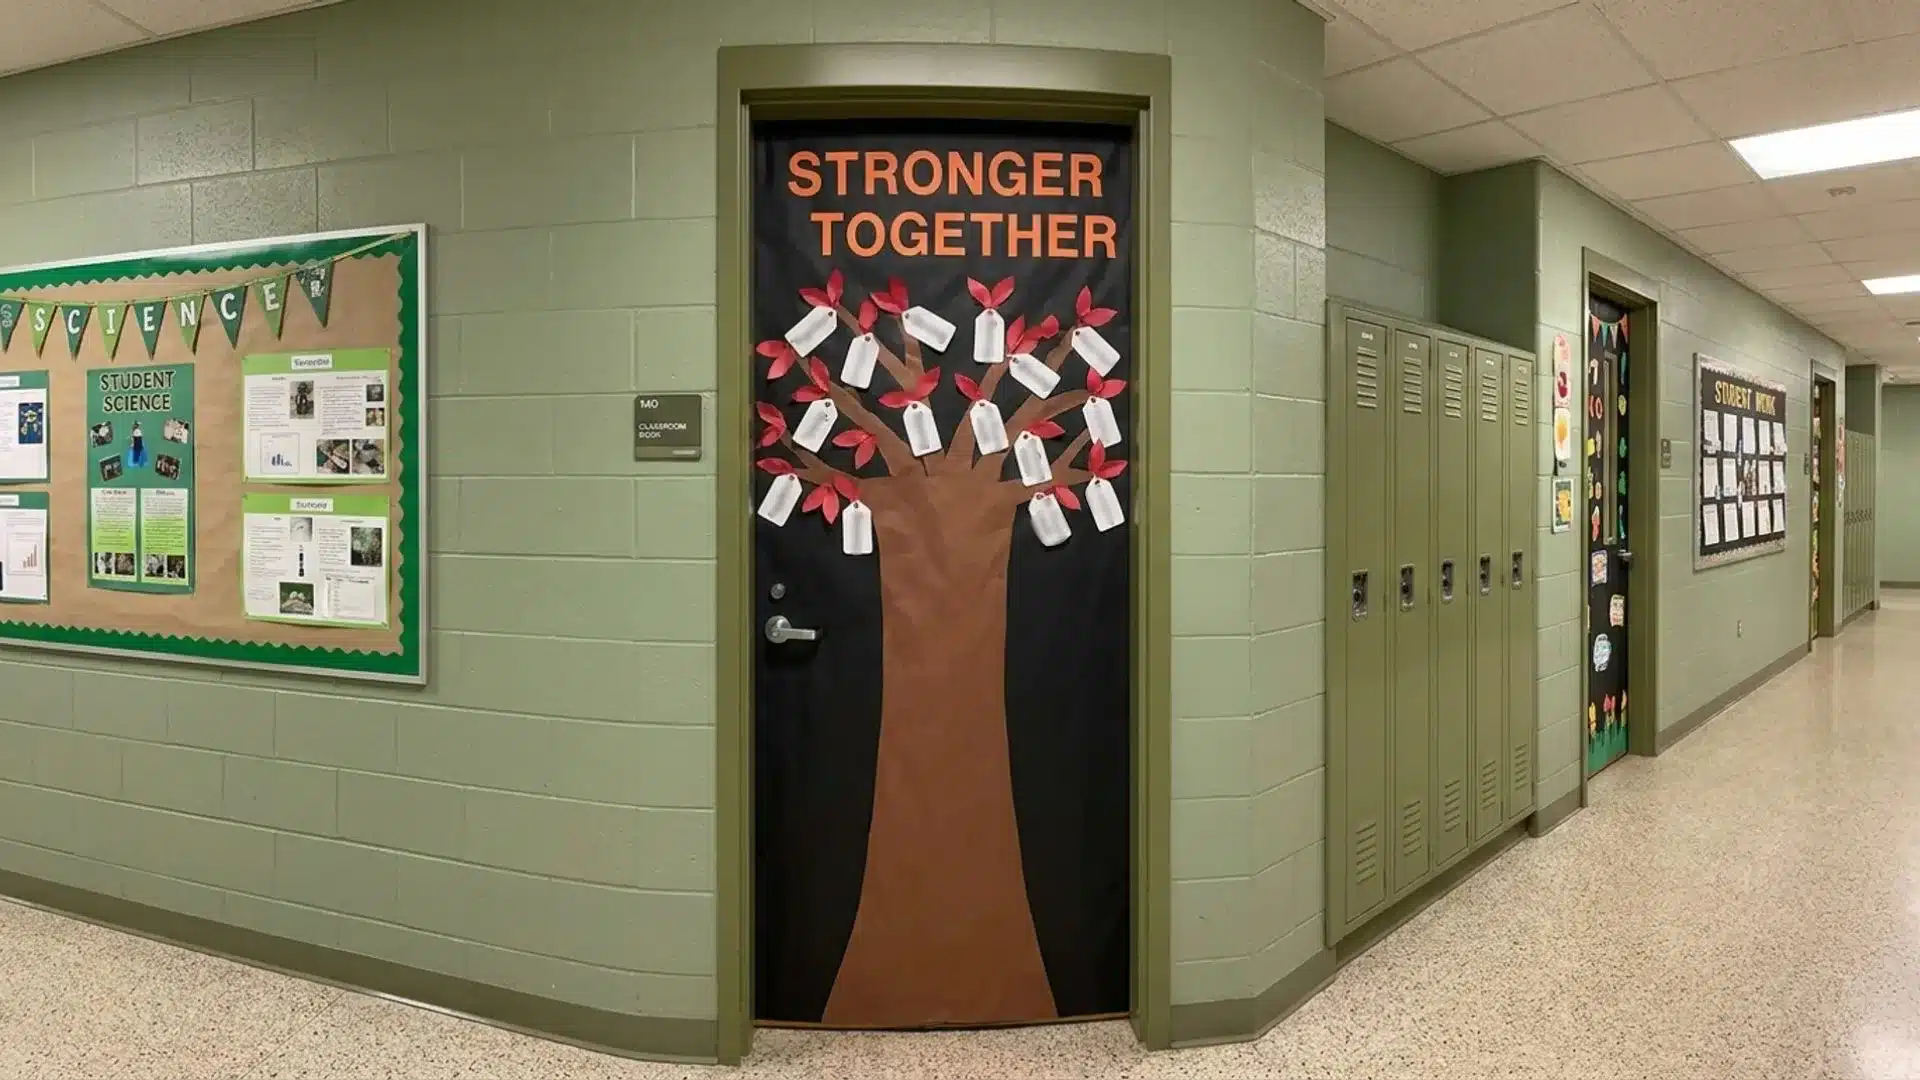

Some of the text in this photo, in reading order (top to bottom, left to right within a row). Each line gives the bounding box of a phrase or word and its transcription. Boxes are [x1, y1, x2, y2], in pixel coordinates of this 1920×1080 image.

[788, 150, 1103, 197] STRONGER
[810, 211, 1117, 259] TOGETHER
[100, 370, 176, 391] STUDENT
[103, 393, 171, 412] SCIENCE
